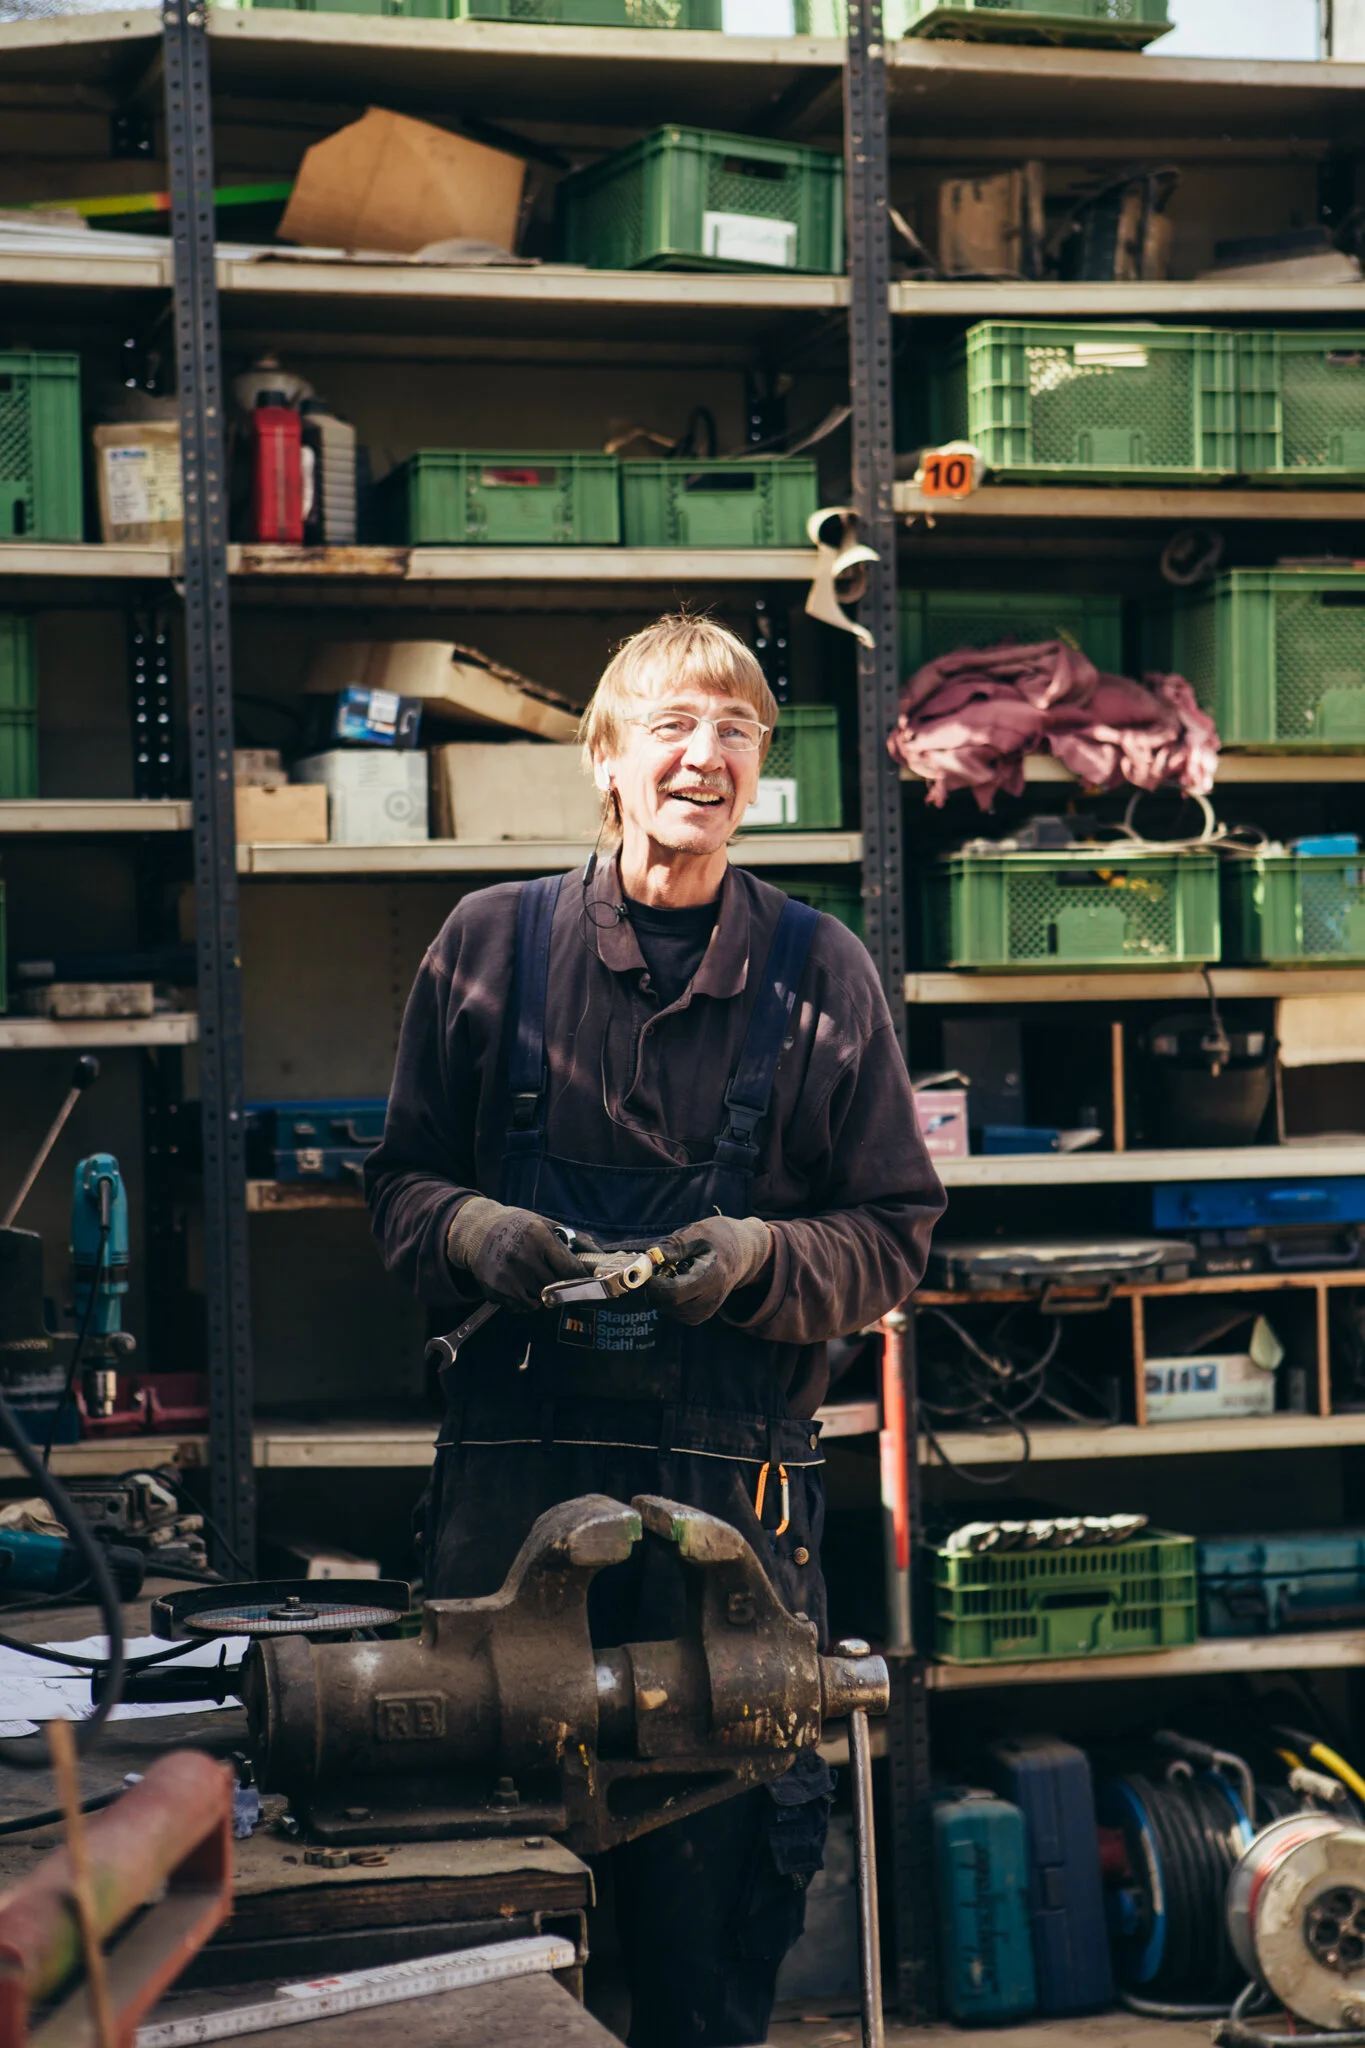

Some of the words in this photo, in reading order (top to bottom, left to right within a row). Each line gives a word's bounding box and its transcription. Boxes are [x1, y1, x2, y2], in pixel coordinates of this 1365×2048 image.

[926, 461, 965, 489] 10
[597, 1309, 659, 1324] Stappert
[596, 1323, 654, 1338] Spezial-
[596, 1338, 633, 1351] Stahl
